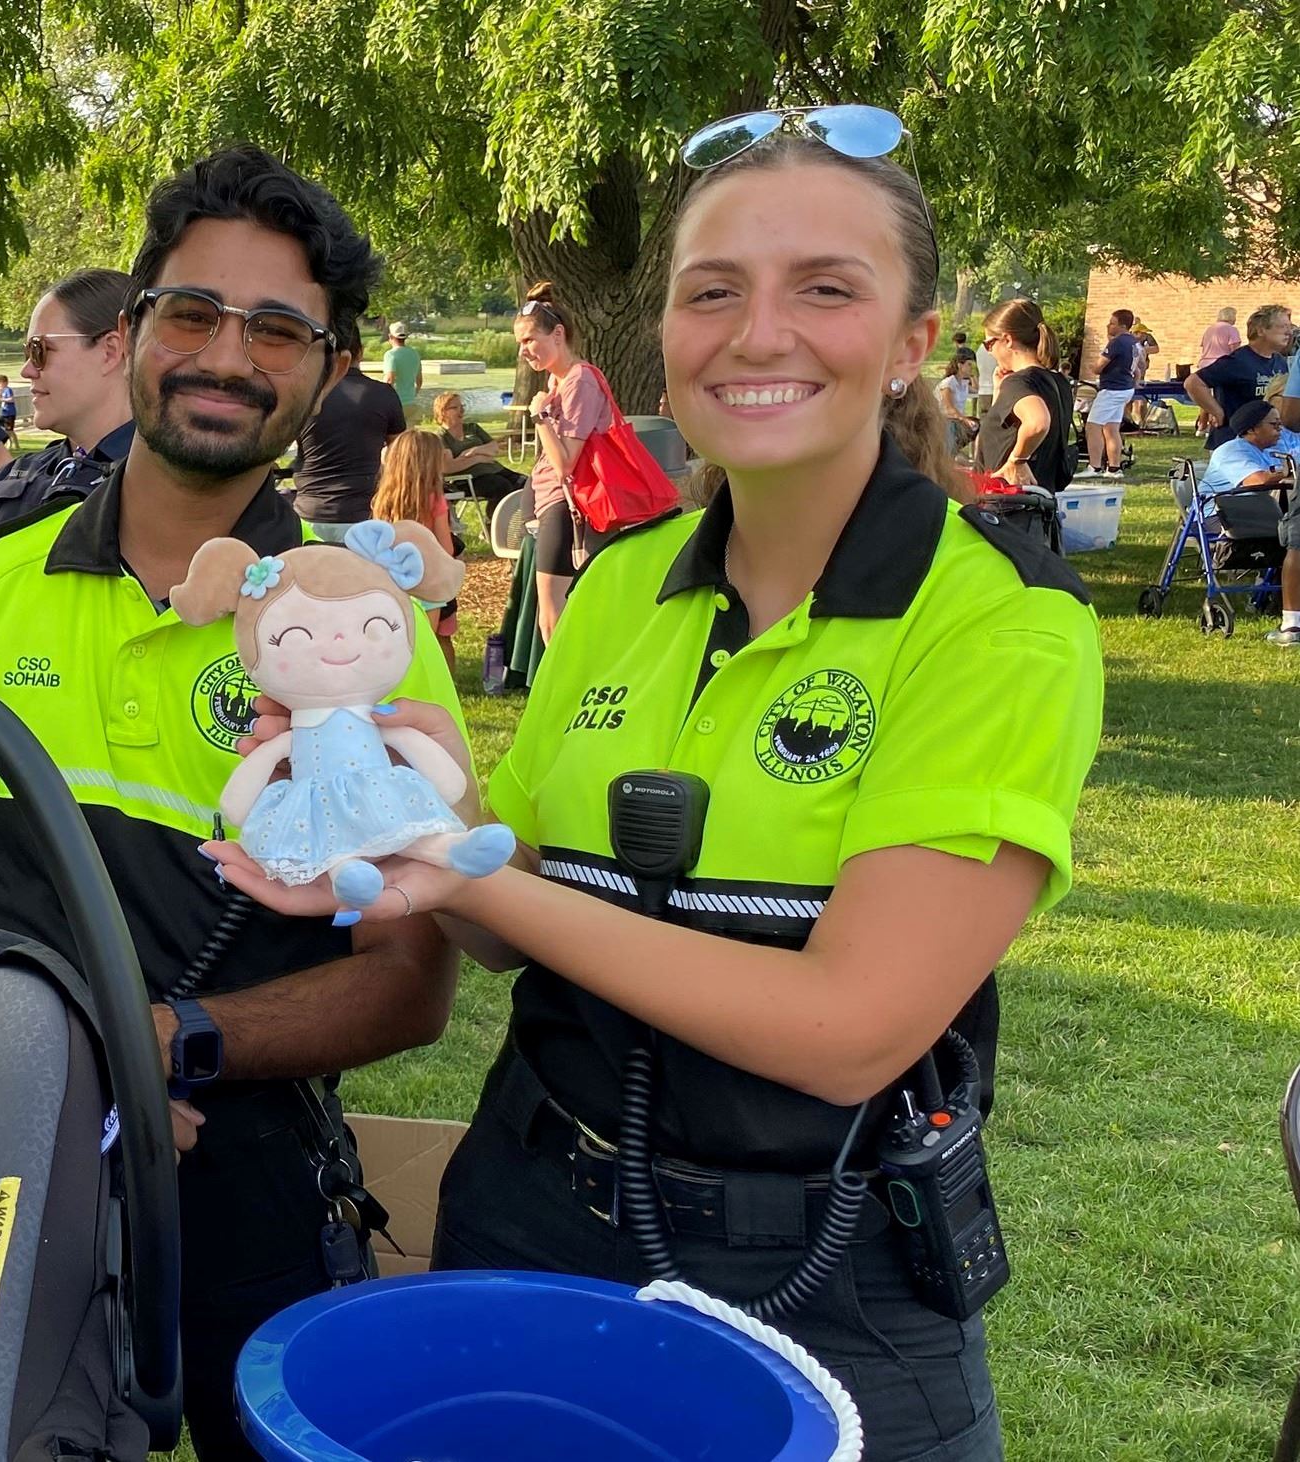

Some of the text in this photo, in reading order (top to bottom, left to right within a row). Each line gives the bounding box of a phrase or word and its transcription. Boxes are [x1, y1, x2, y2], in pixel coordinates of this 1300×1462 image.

[17, 656, 51, 671] CSO
[3, 671, 60, 687] SOHAIB
[200, 664, 225, 695] CITY
[581, 686, 628, 707] CSO
[214, 696, 241, 732] FEBRUARY
[758, 671, 872, 754] CITY OF WHEATON
[206, 724, 234, 747] ILLI
[774, 735, 802, 763] FEBRUARY
[759, 748, 844, 781] ILLINOIS
[634, 786, 676, 797] MOTOROLA
[941, 1126, 977, 1159] MOTOROLA
